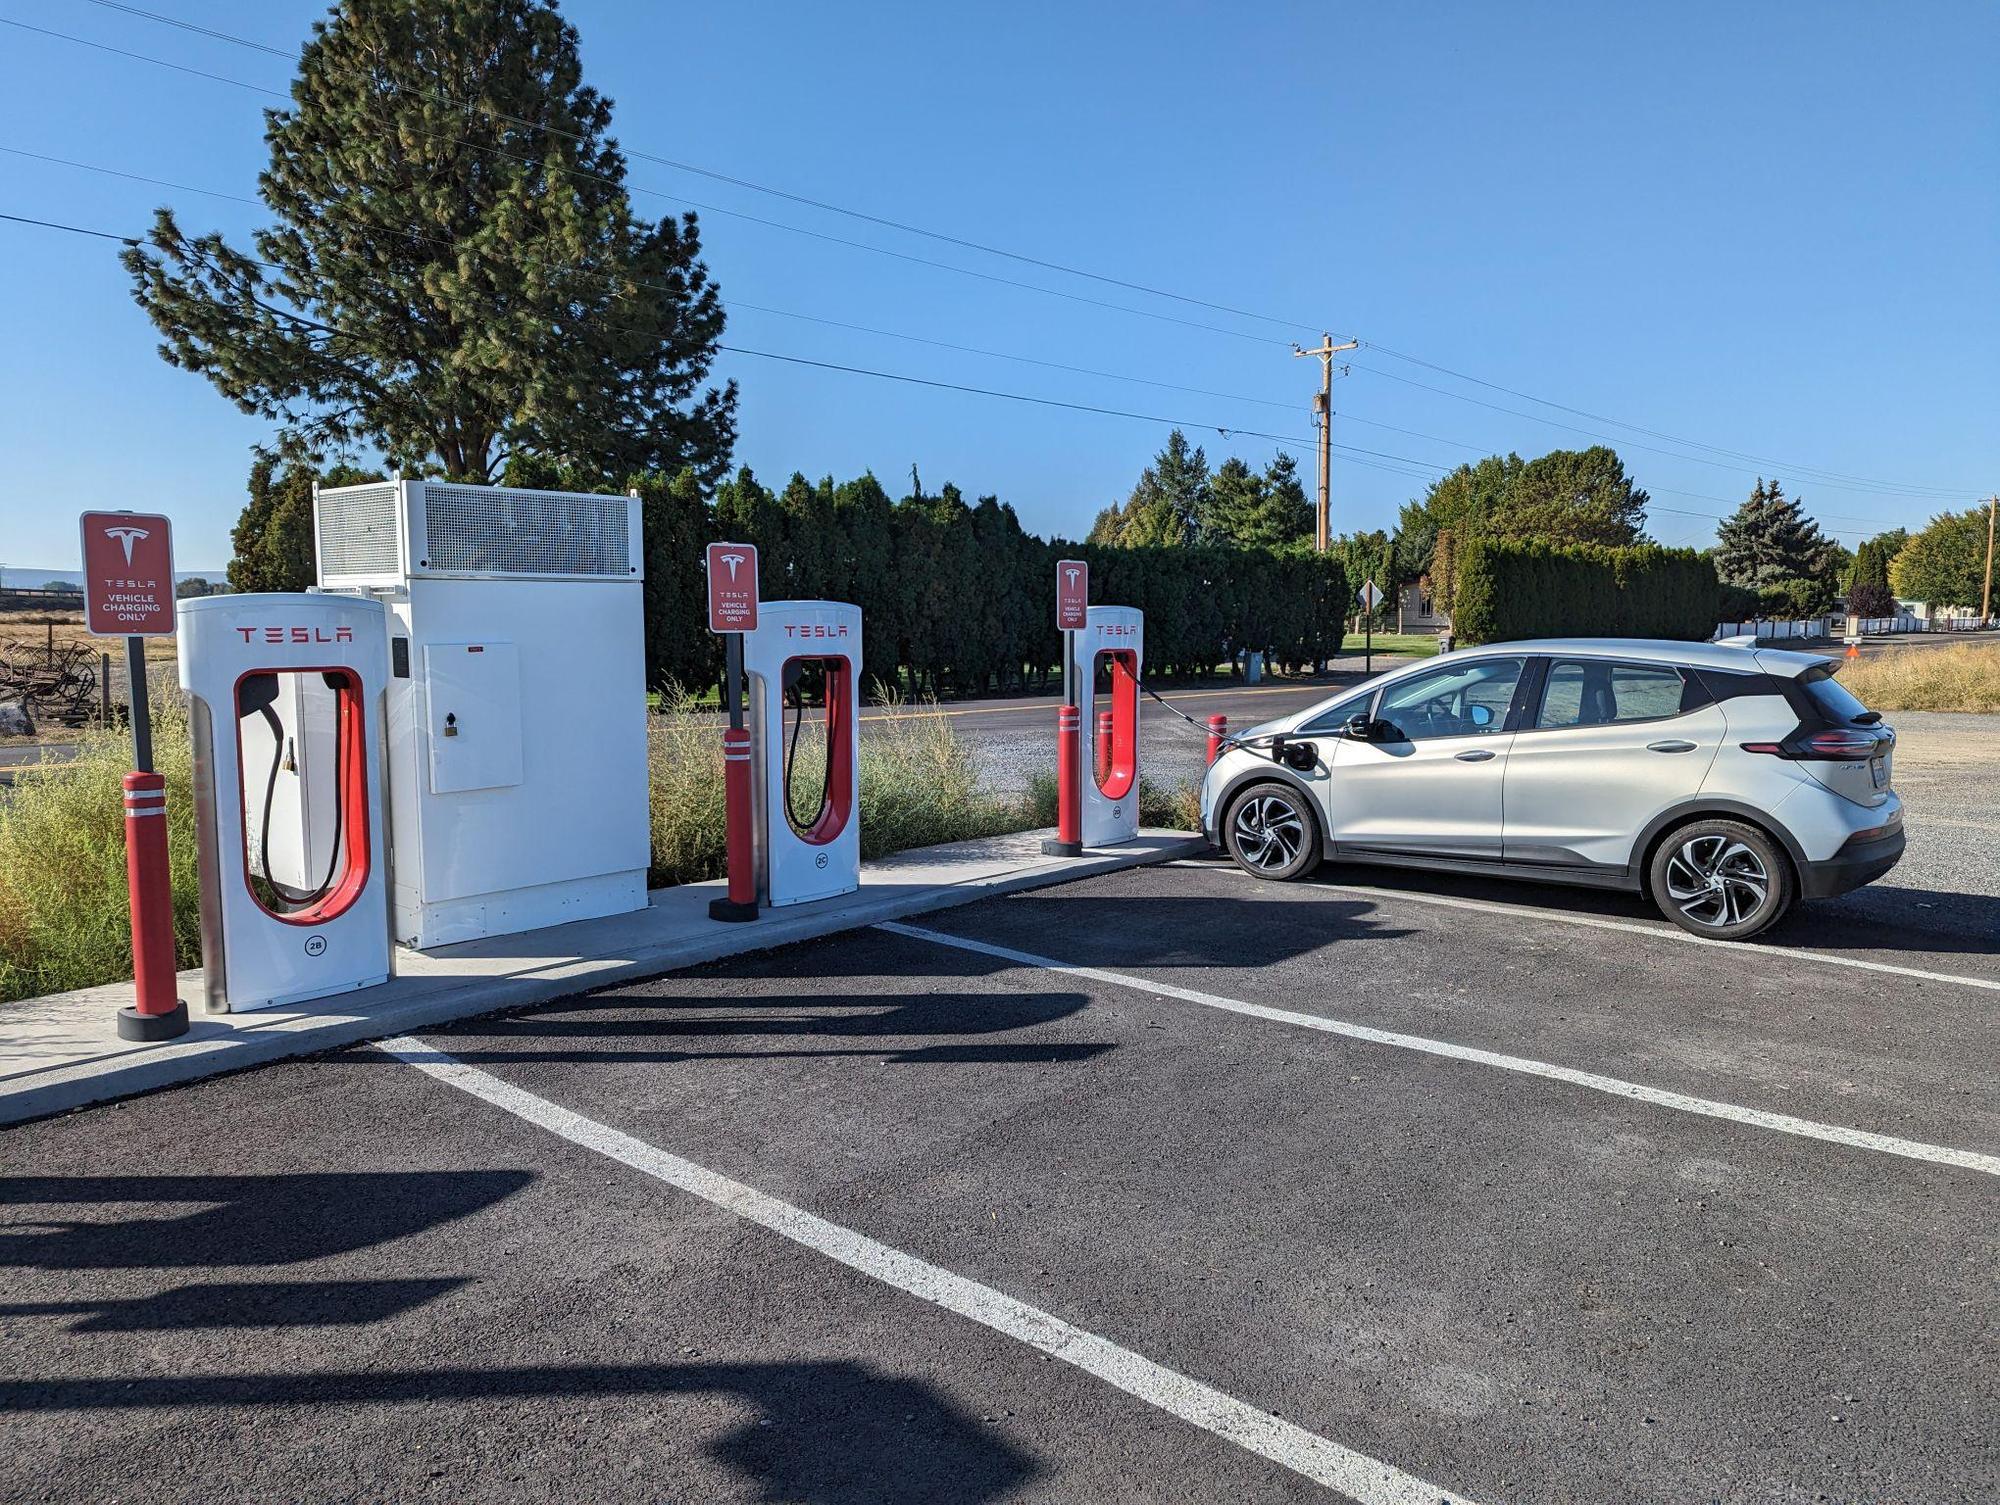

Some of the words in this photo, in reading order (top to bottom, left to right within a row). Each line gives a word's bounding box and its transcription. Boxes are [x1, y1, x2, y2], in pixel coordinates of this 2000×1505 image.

[105, 580, 156, 588] TESLA
[108, 594, 154, 602] VEHICLE
[102, 603, 160, 612] CHARGING
[718, 608, 750, 616] CHARGING
[118, 613, 146, 621] ONLY
[726, 615, 743, 623] ONLY
[784, 625, 848, 638] TESLA
[1096, 625, 1137, 635] TESLA
[236, 627, 352, 643] TESLA
[310, 942, 321, 950] 2B
